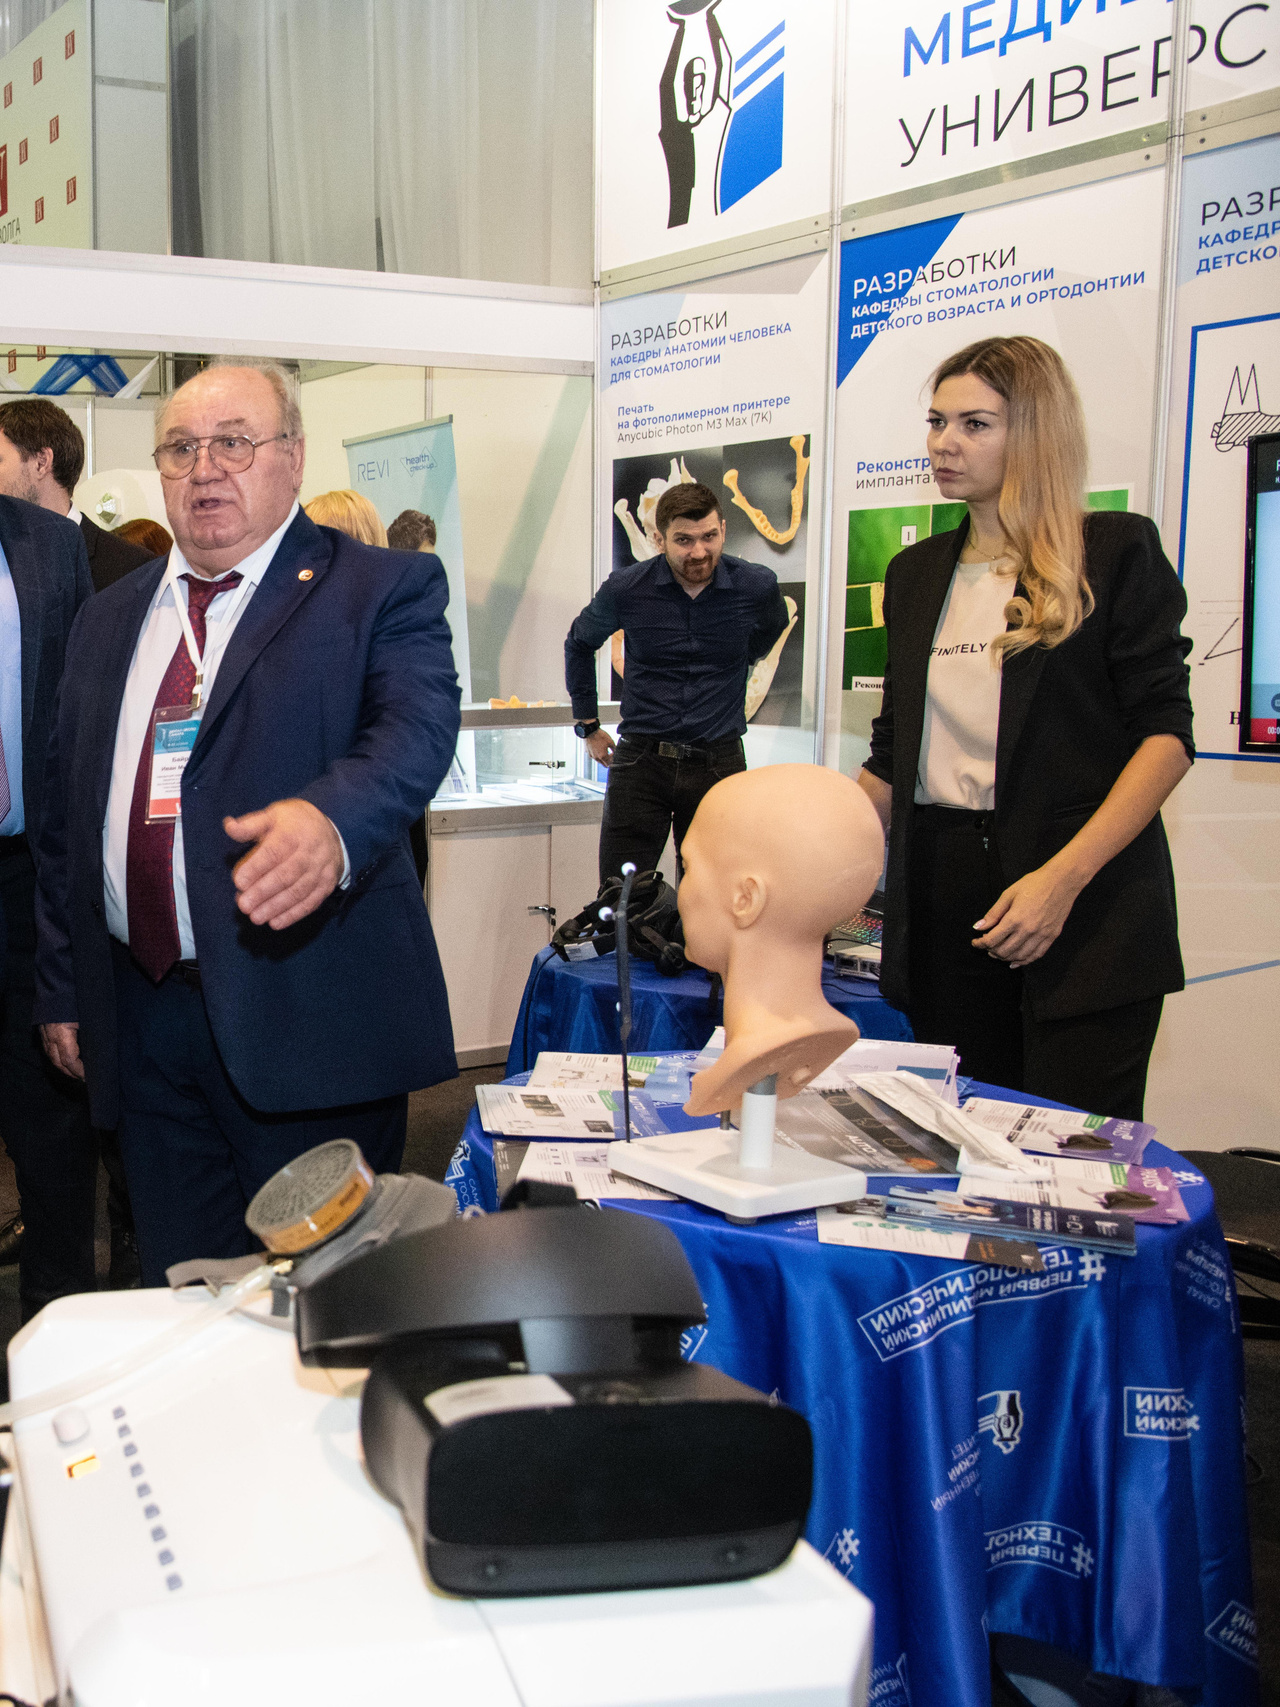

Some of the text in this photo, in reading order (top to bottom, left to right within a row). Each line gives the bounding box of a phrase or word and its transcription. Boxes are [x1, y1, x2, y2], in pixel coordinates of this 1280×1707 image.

[899, 4, 1270, 167] УНИВЕРС
[852, 245, 1017, 299] РАЗРАБОТКИ
[1196, 245, 1280, 275] ДЕТСКО
[850, 270, 1146, 339] ДЕТСКОГО ВОЗРАСТА И ОРТОДОНТИИ
[851, 267, 1055, 319] КАФЕДРЫ СТОМАТОЛОГИИ
[610, 322, 792, 368] КАФЕДРЫ АНАТОМИИ ЧЕЛОВЕКА
[611, 310, 728, 350] РАЗРАБОТКИ
[610, 353, 721, 385] ДЛЯ СТОМАТОЛОГИИ
[617, 403, 655, 417] Печать
[617, 395, 791, 430] на фотополимерном принтере
[617, 410, 773, 444] Anycubic Photon M3 Max (7K)
[856, 457, 932, 474] Реконстр
